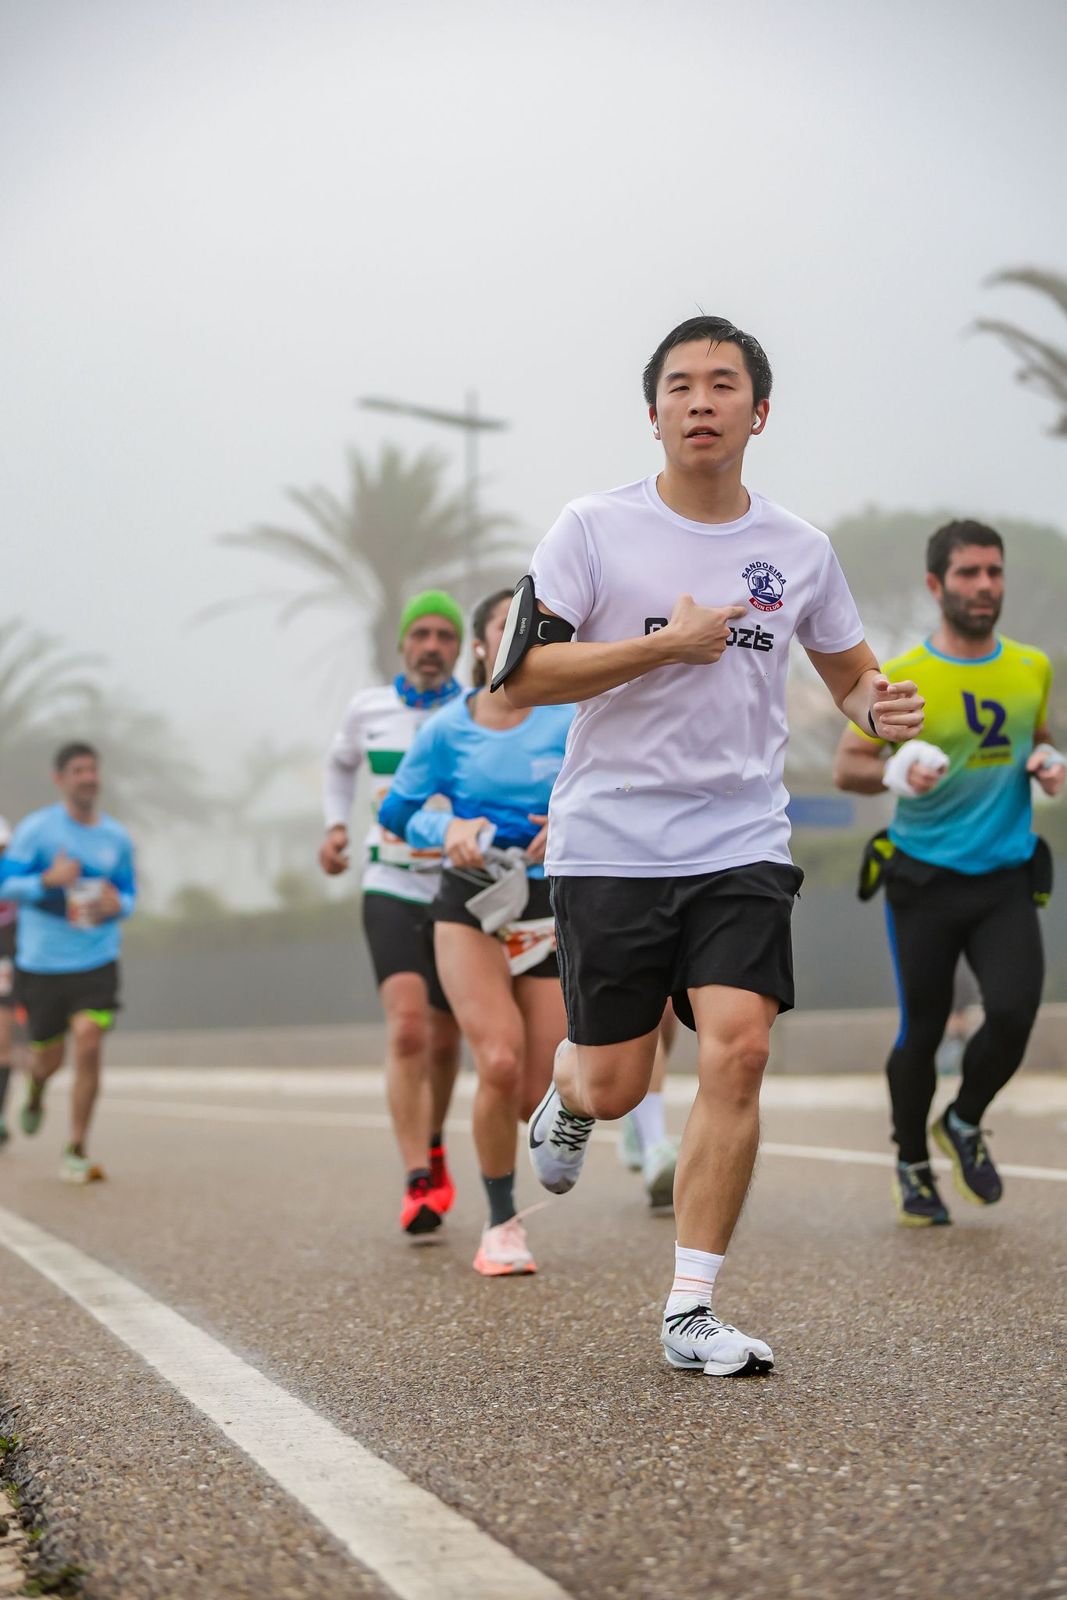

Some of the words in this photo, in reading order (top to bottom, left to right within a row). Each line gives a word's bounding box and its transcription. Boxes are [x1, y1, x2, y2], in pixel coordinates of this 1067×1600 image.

[741, 561, 787, 585] SANDOEIRA
[752, 600, 765, 611] RUN
[765, 603, 781, 611] CLUB
